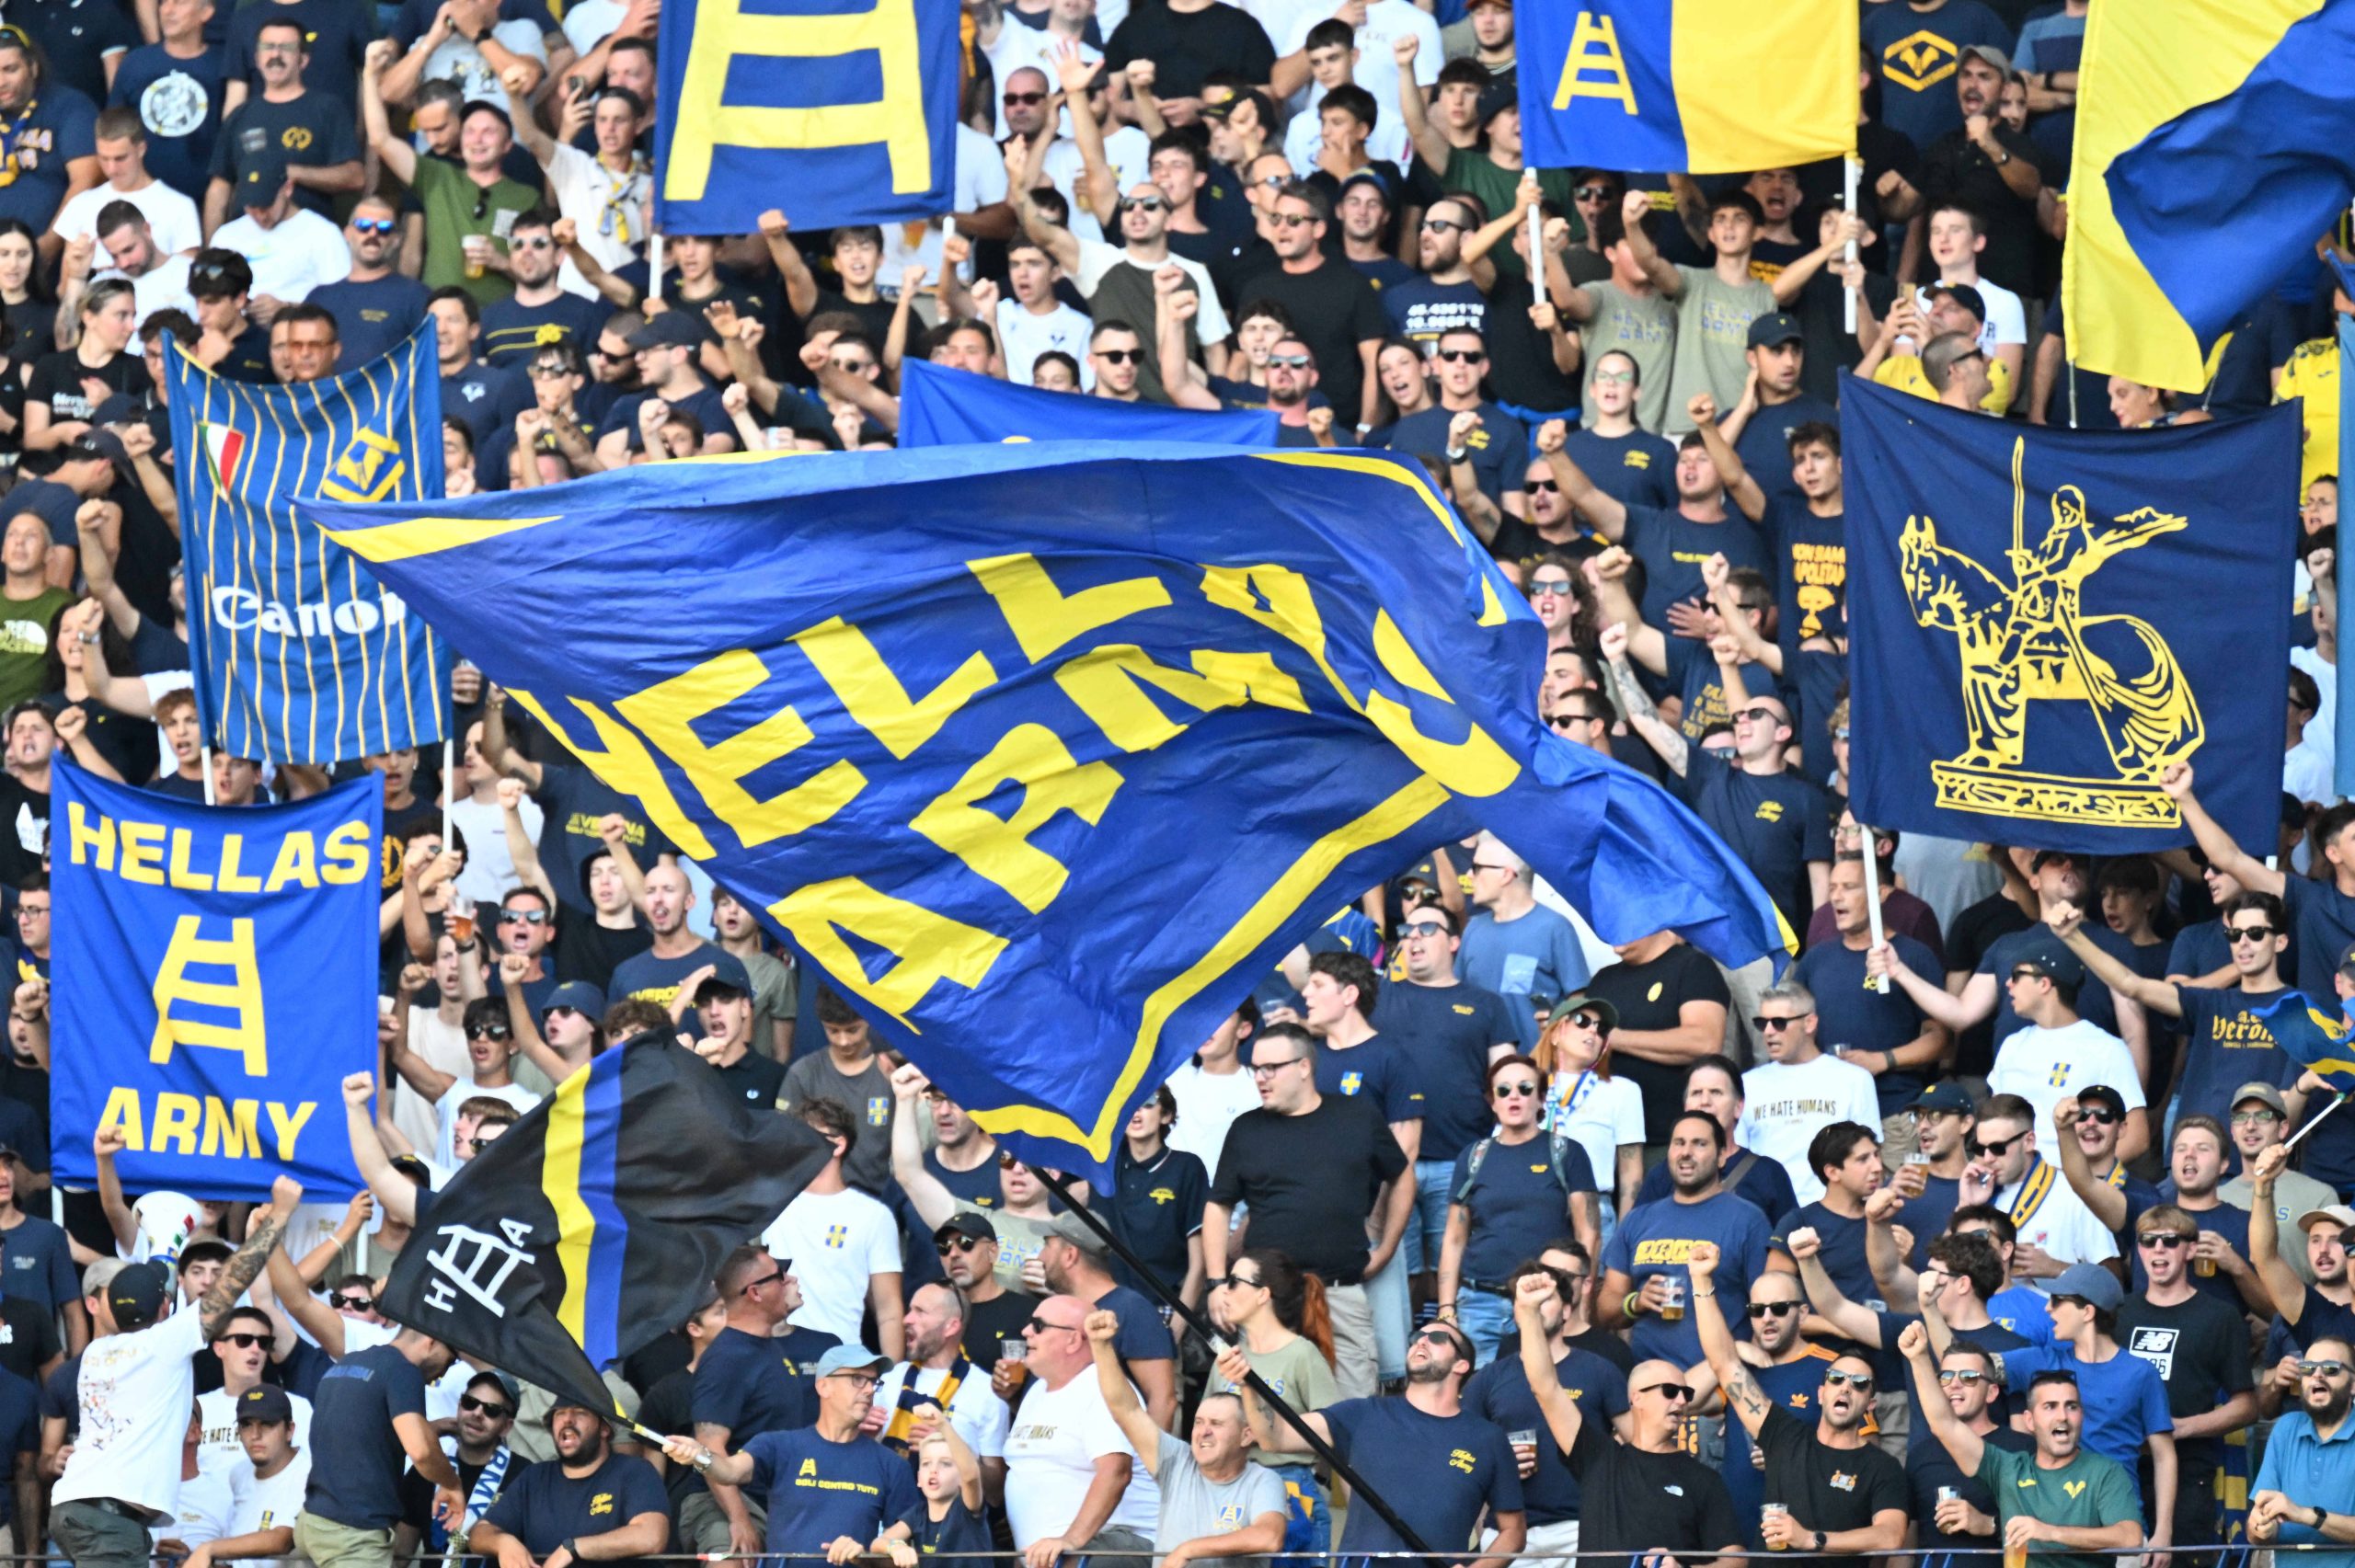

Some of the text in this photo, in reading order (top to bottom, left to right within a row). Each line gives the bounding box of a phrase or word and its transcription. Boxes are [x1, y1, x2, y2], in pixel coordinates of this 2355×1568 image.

[67, 801, 371, 893] HELLAS
[580, 814, 646, 840] VENA
[98, 1086, 318, 1162] ARMY
[1753, 1099, 1837, 1122] WE HATE HUMANS
[423, 1218, 534, 1314] H A
[210, 1427, 232, 1443] HATE
[466, 1450, 510, 1518] RMY
[818, 1480, 856, 1492] CONTRO
